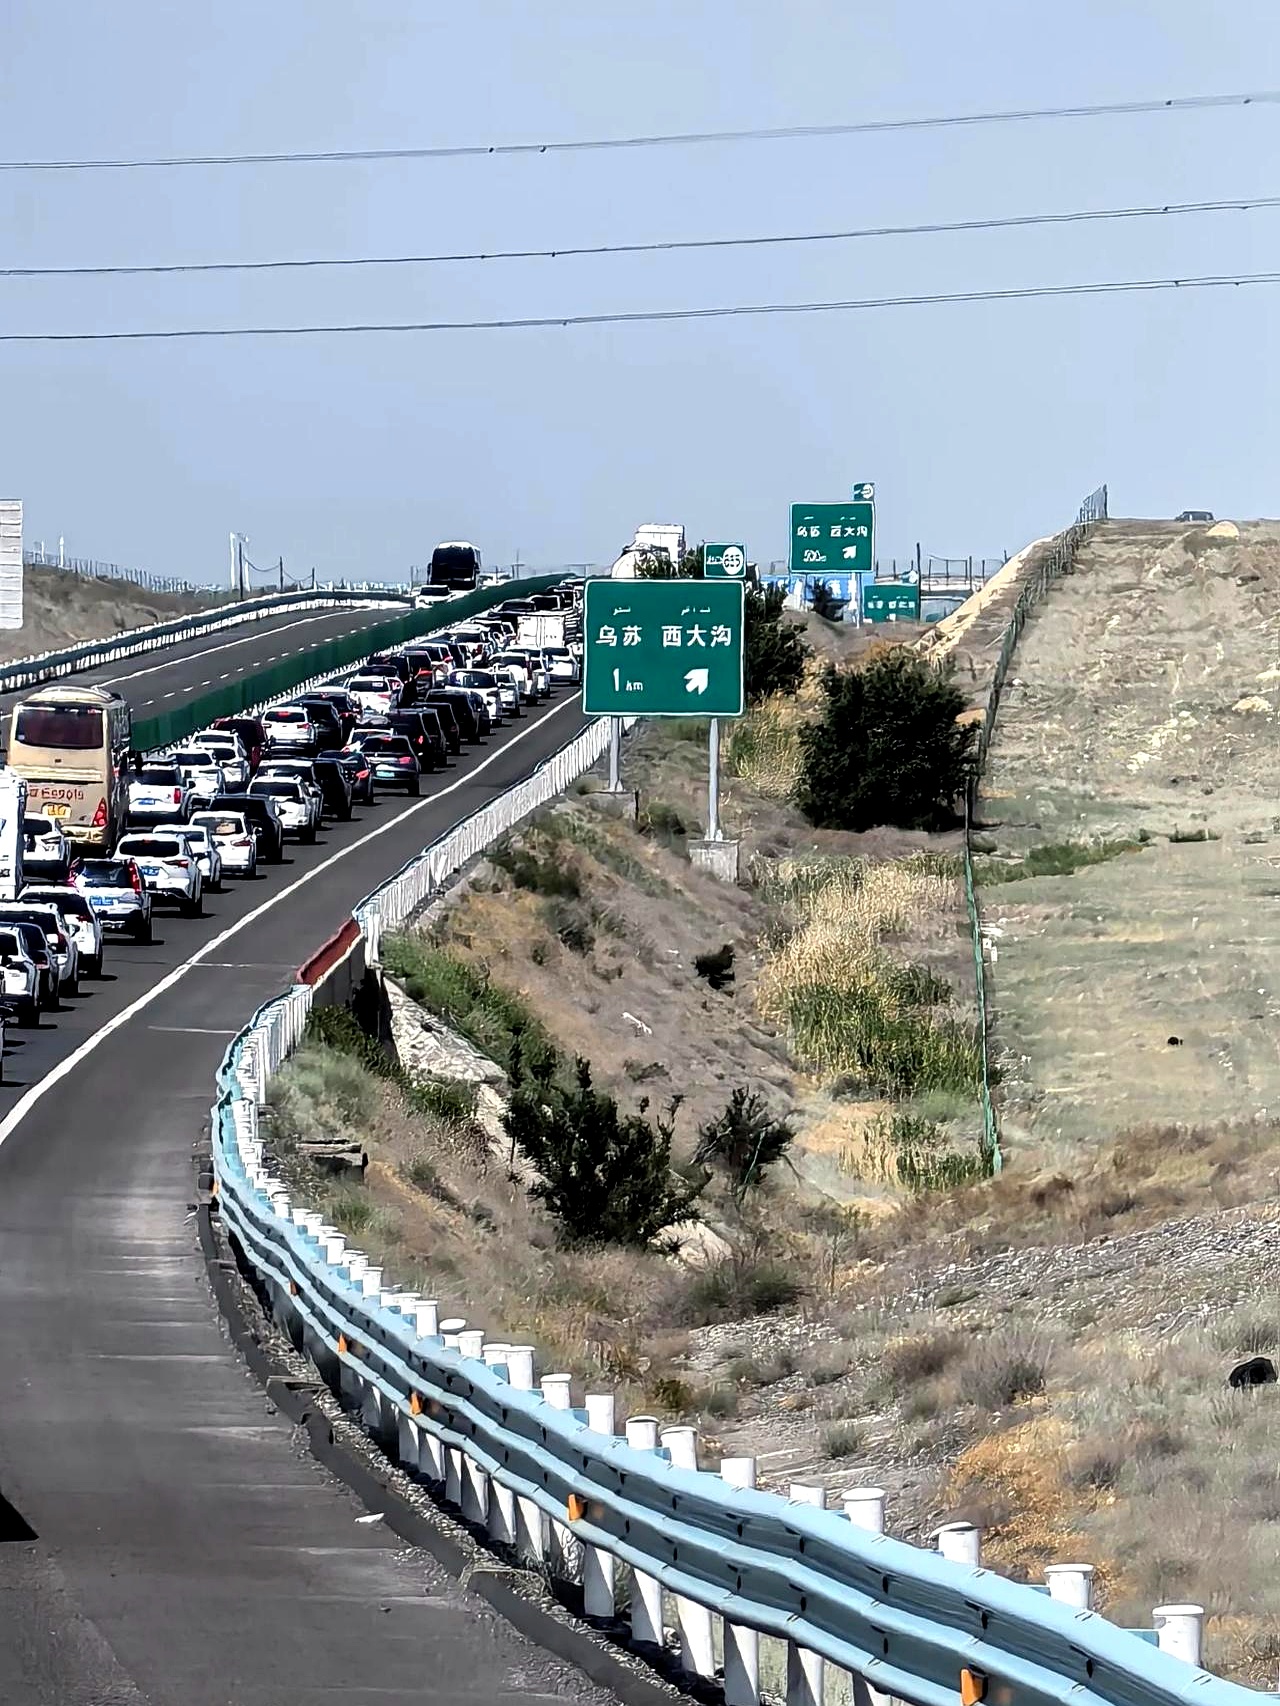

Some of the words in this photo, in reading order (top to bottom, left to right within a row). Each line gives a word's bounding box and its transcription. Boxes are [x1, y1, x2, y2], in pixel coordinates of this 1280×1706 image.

[595, 624, 643, 647] 乌苏
[661, 623, 732, 648] 西大沟
[612, 667, 620, 692] 1
